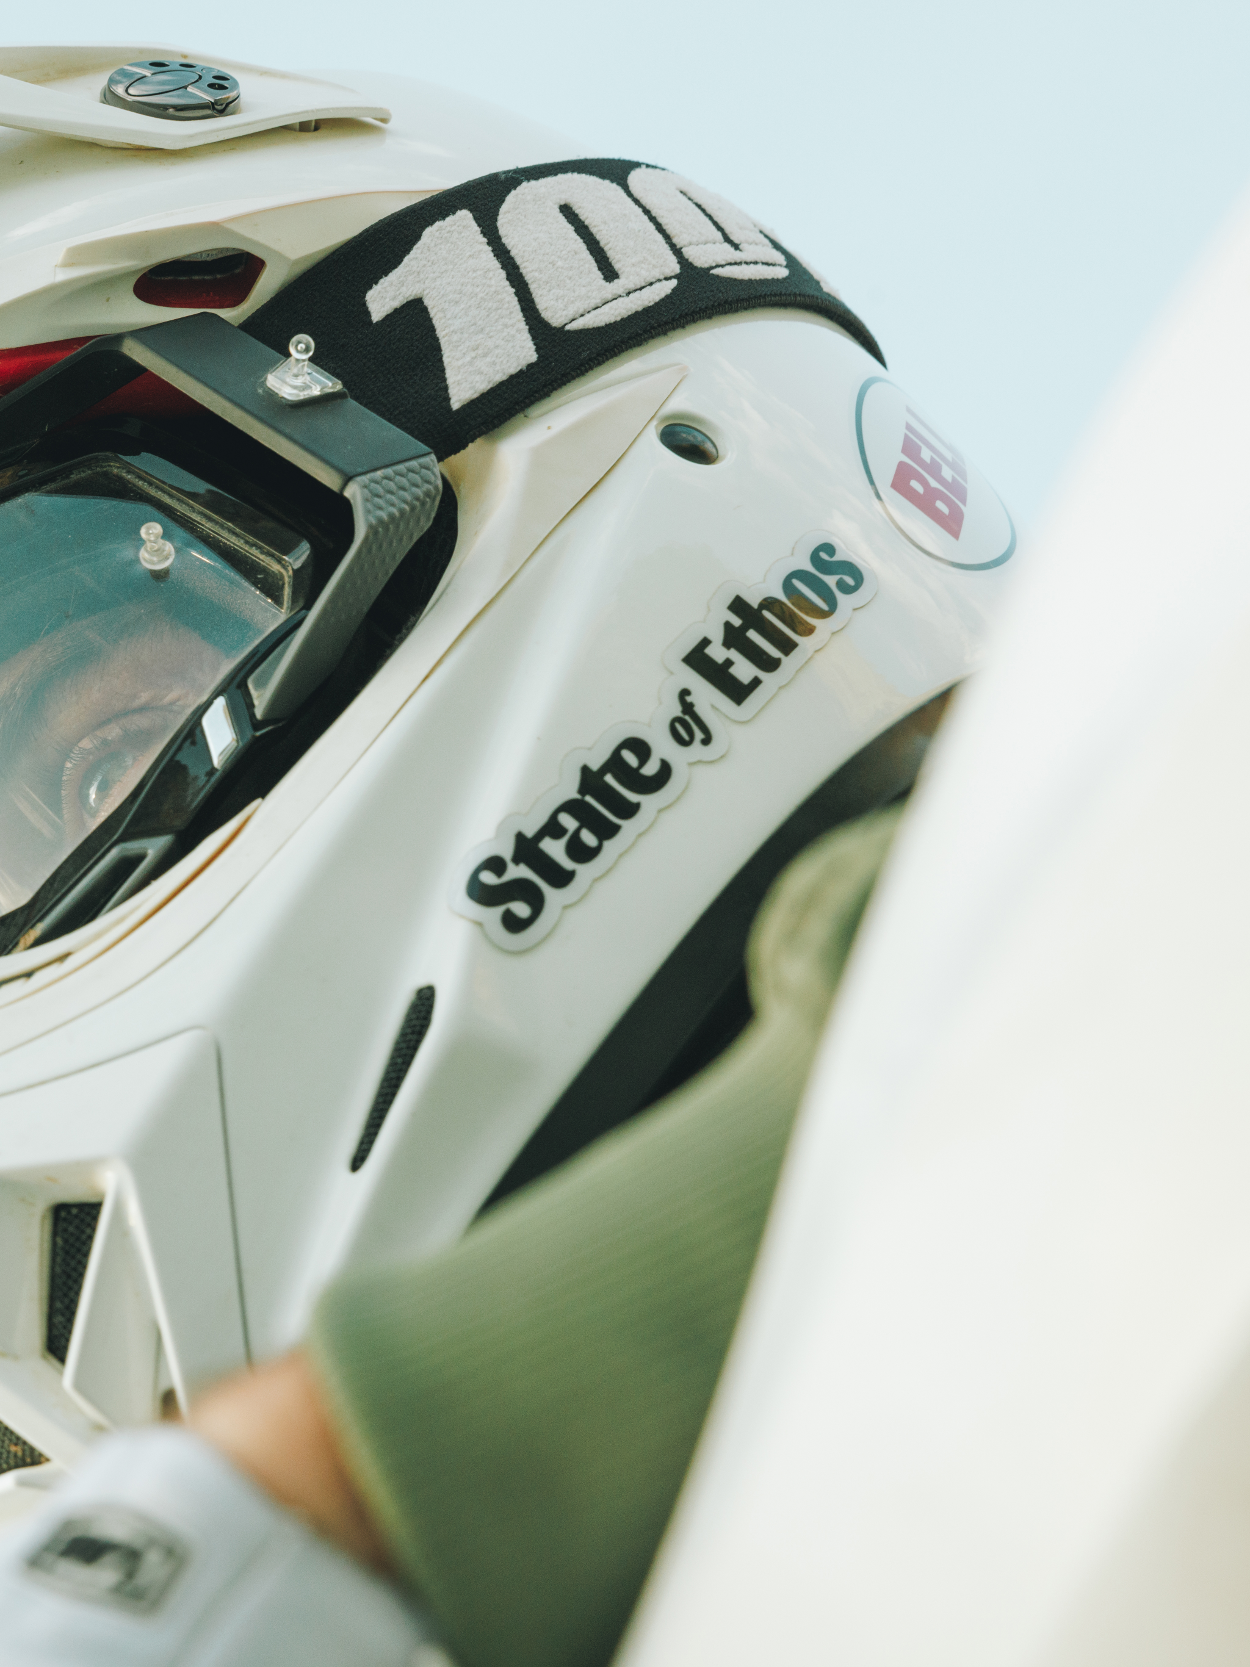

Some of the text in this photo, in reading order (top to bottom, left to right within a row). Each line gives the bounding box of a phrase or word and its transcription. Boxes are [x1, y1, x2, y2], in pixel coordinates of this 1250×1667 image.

[365, 166, 840, 411] 100
[466, 542, 864, 934] State of Ethos
